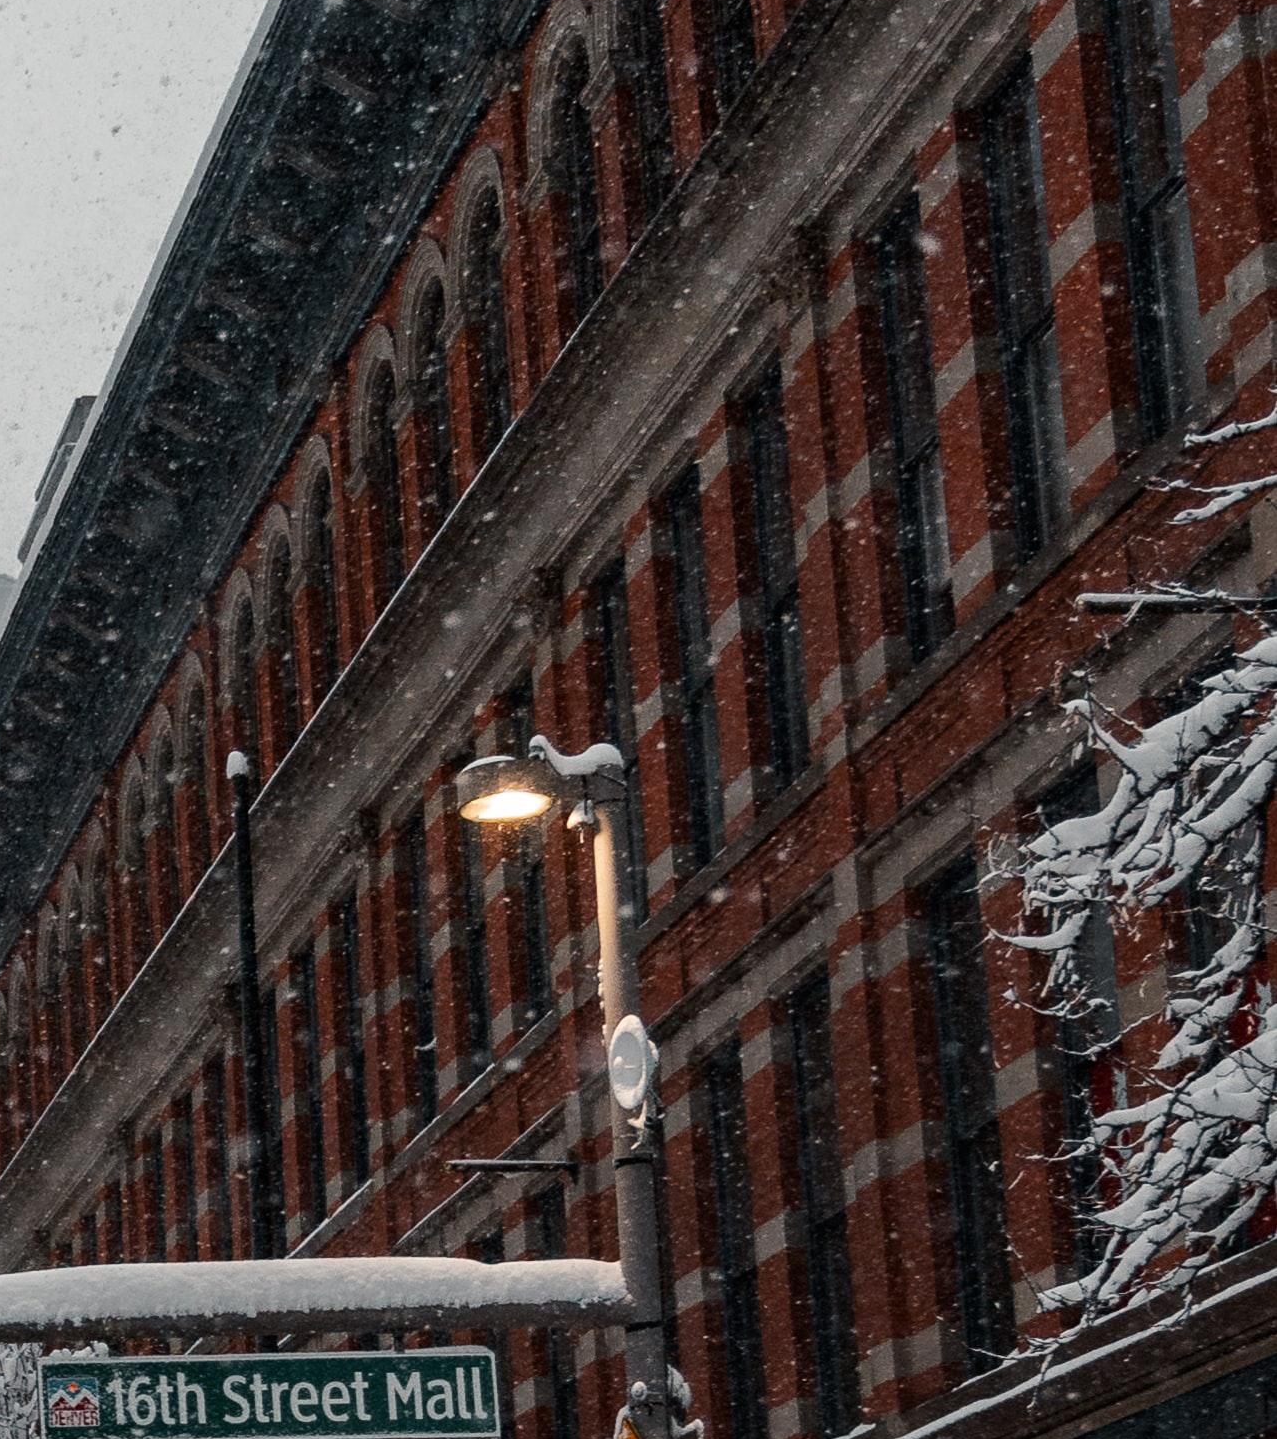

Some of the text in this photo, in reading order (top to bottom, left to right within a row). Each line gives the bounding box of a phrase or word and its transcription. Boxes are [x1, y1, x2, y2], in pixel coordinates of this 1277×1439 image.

[106, 1367, 488, 1426] 16th Street Mall
